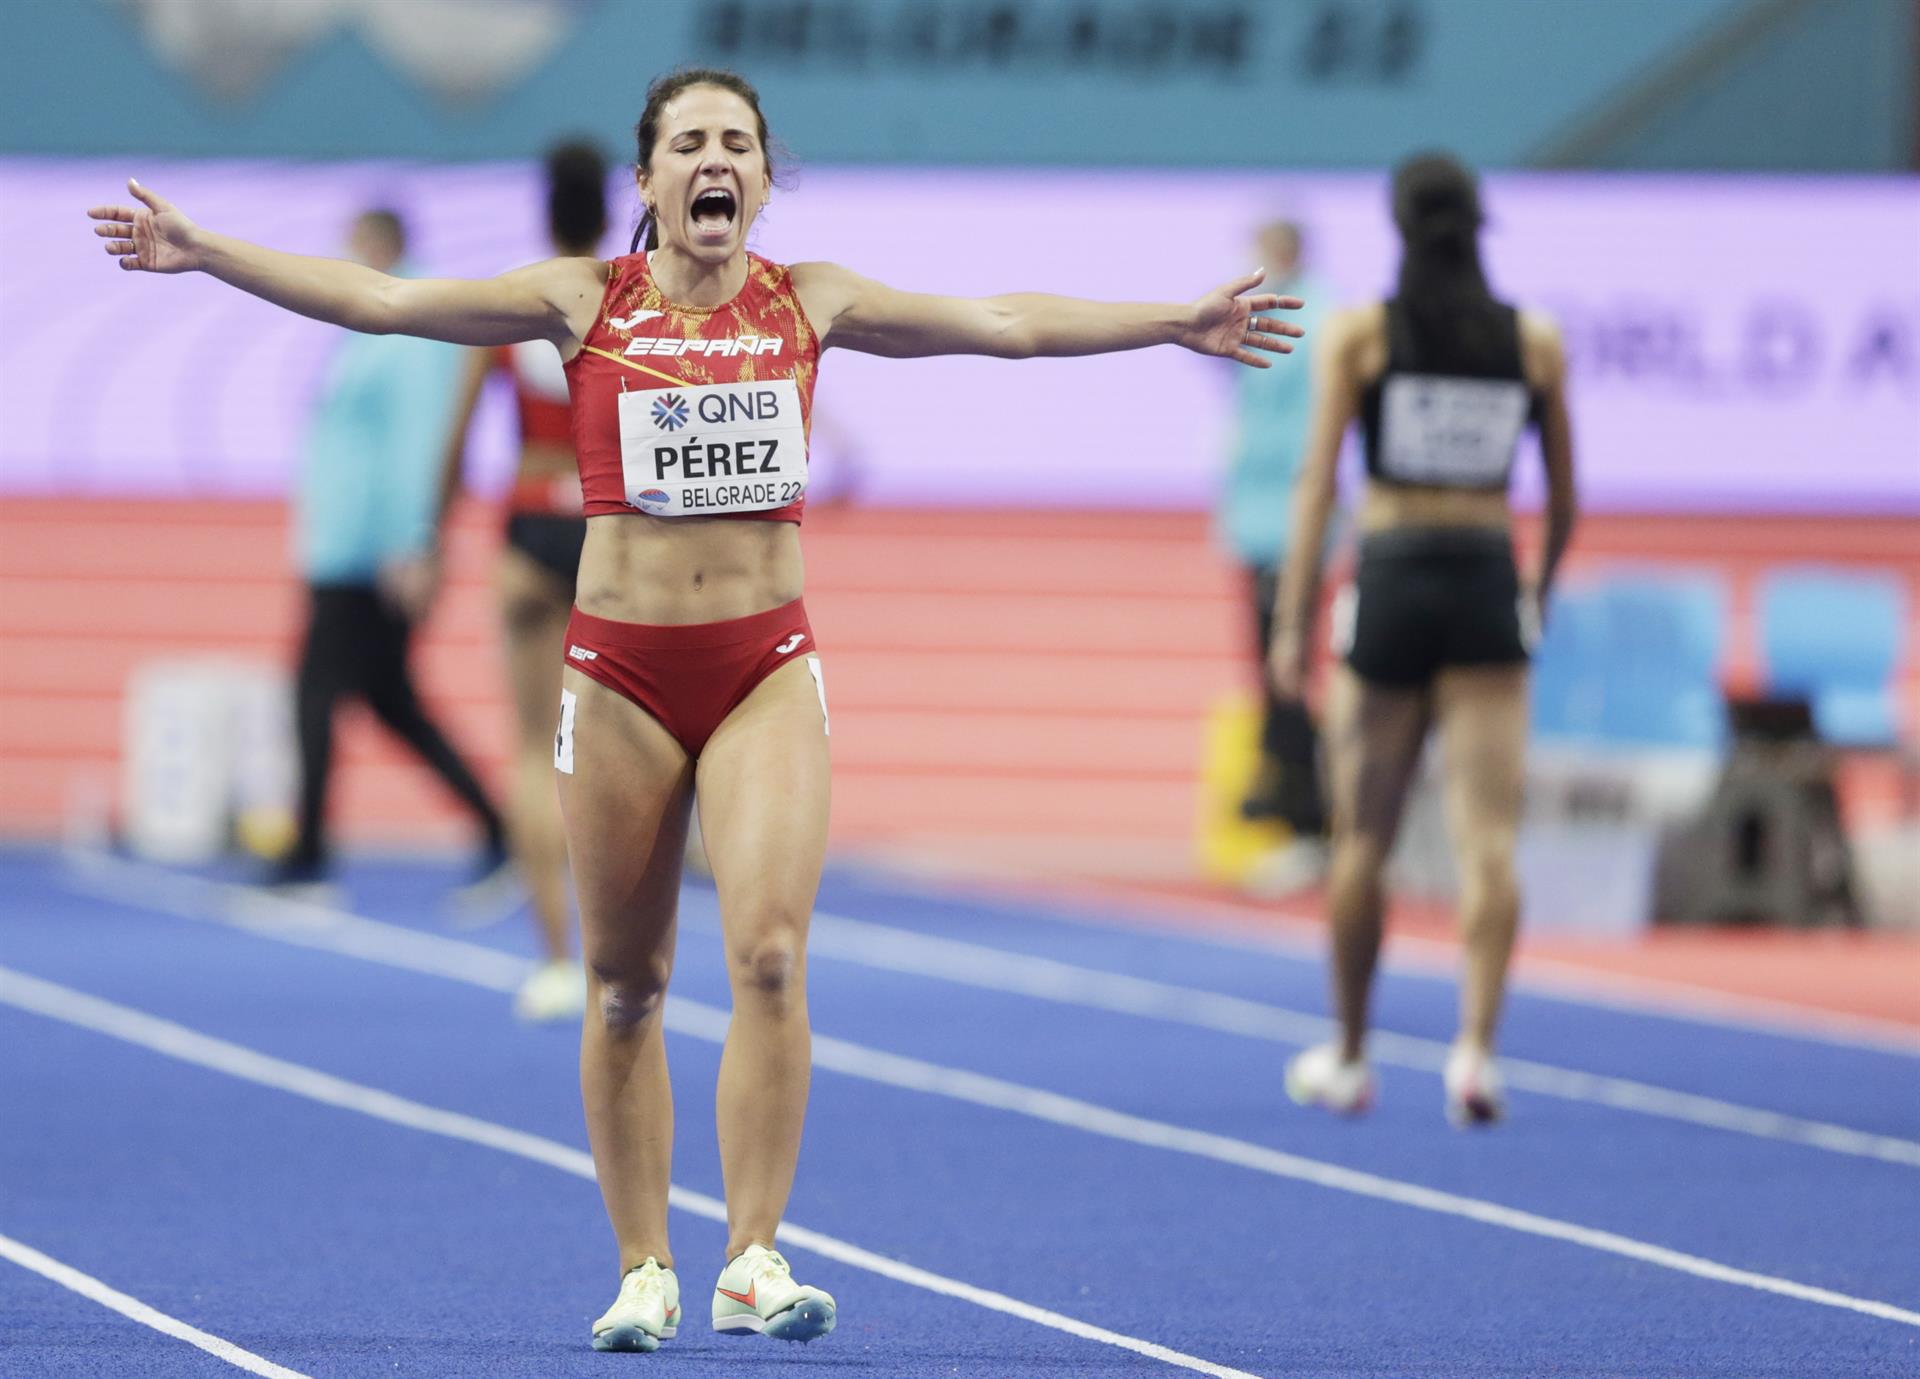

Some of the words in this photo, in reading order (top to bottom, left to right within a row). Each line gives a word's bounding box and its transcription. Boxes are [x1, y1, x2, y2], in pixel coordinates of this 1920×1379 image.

[623, 335, 784, 357] ESPAÑA
[697, 390, 780, 424] QNB
[654, 436, 781, 480] PÉREZ
[682, 483, 776, 508] BELGRADE
[780, 481, 802, 501] 22
